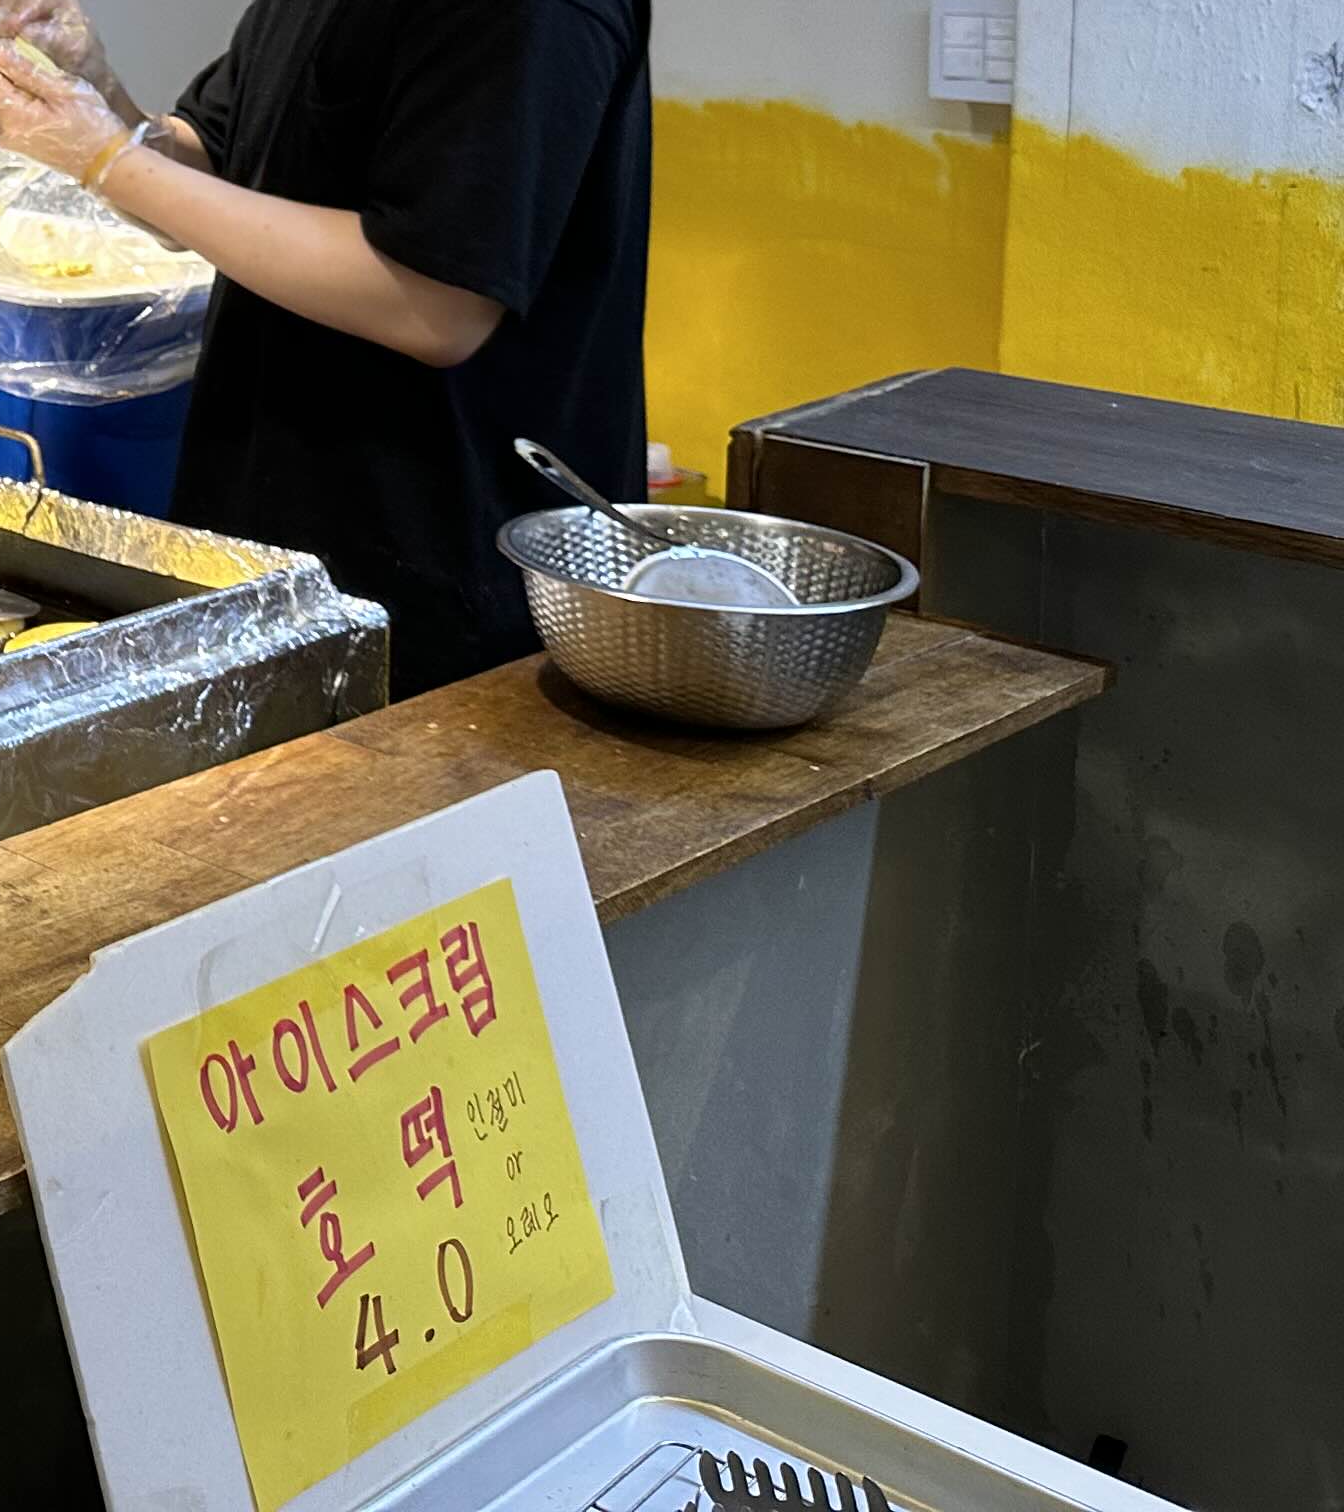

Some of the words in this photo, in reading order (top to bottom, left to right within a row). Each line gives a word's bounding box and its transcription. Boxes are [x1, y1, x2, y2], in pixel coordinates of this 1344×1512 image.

[198, 920, 499, 1134] 아이스크림
[506, 1150, 524, 1180] or
[354, 1236, 476, 1376] 4.0
